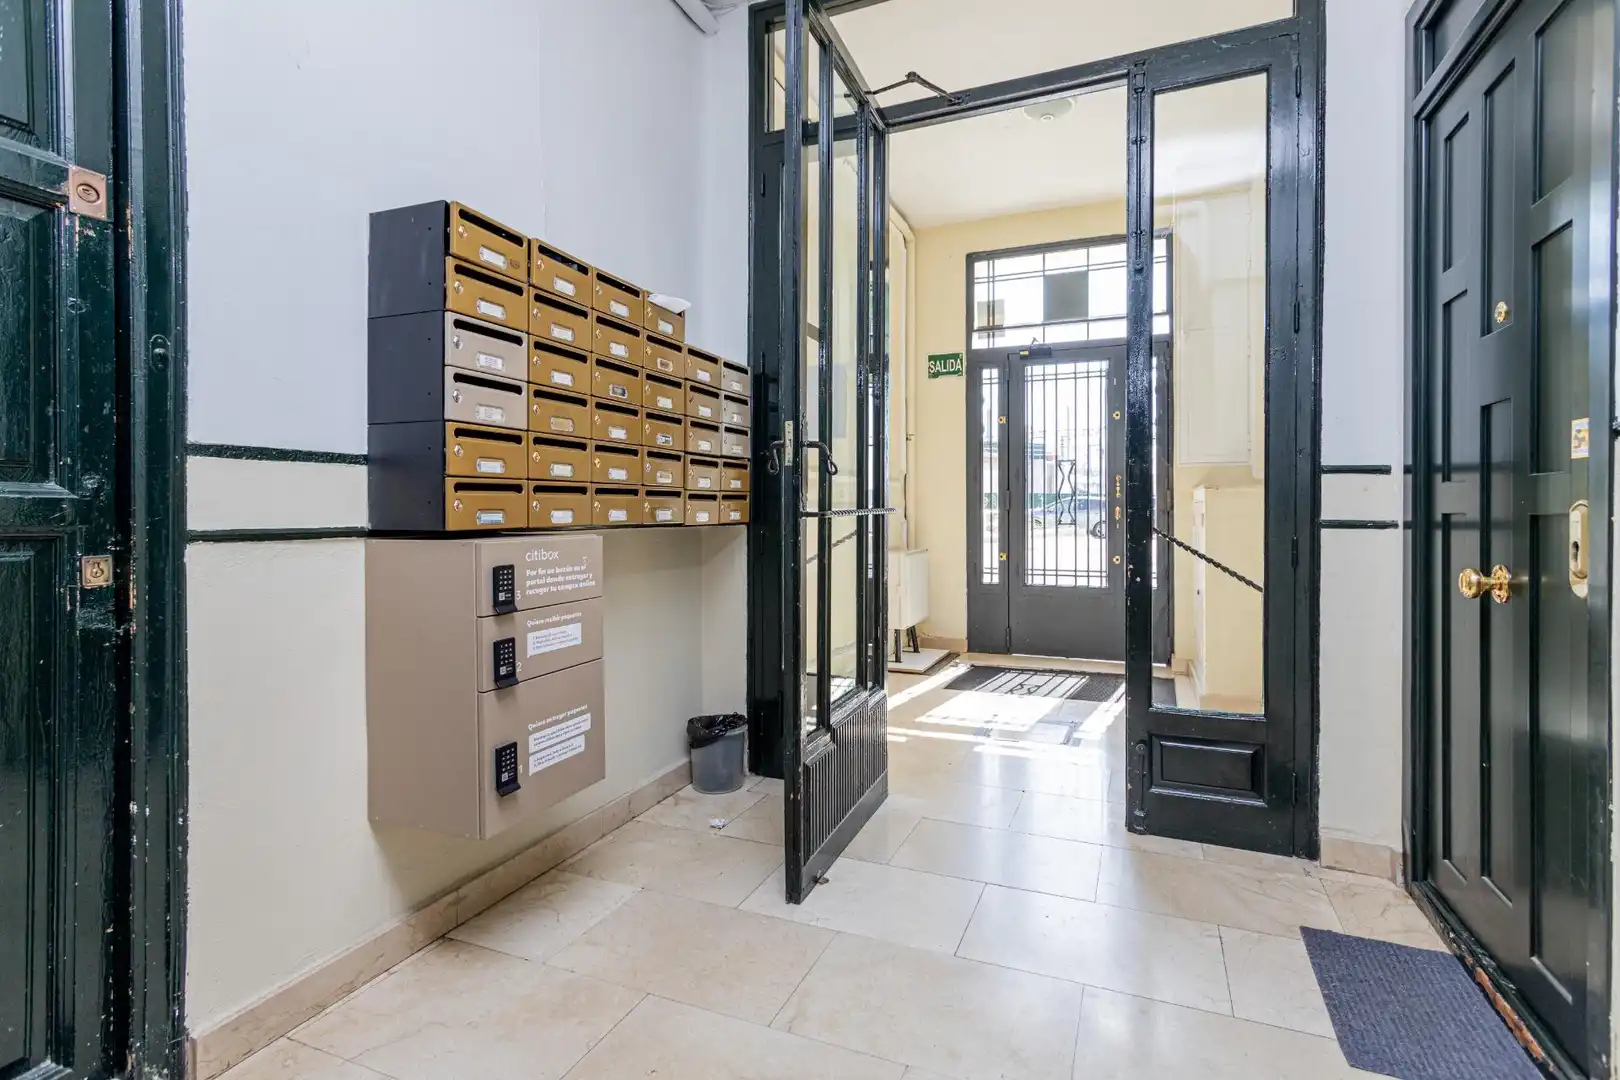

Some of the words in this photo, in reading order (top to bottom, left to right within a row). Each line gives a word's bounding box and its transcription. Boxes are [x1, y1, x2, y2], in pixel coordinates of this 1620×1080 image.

[929, 359, 962, 373] SALIDA
[525, 548, 559, 562] citibox
[526, 569, 537, 577] Por
[526, 577, 545, 587] portal
[546, 574, 564, 583] donde
[516, 590, 521, 600] 3
[526, 586, 549, 595] recoger
[516, 661, 522, 672] 2
[518, 764, 523, 773] 1
